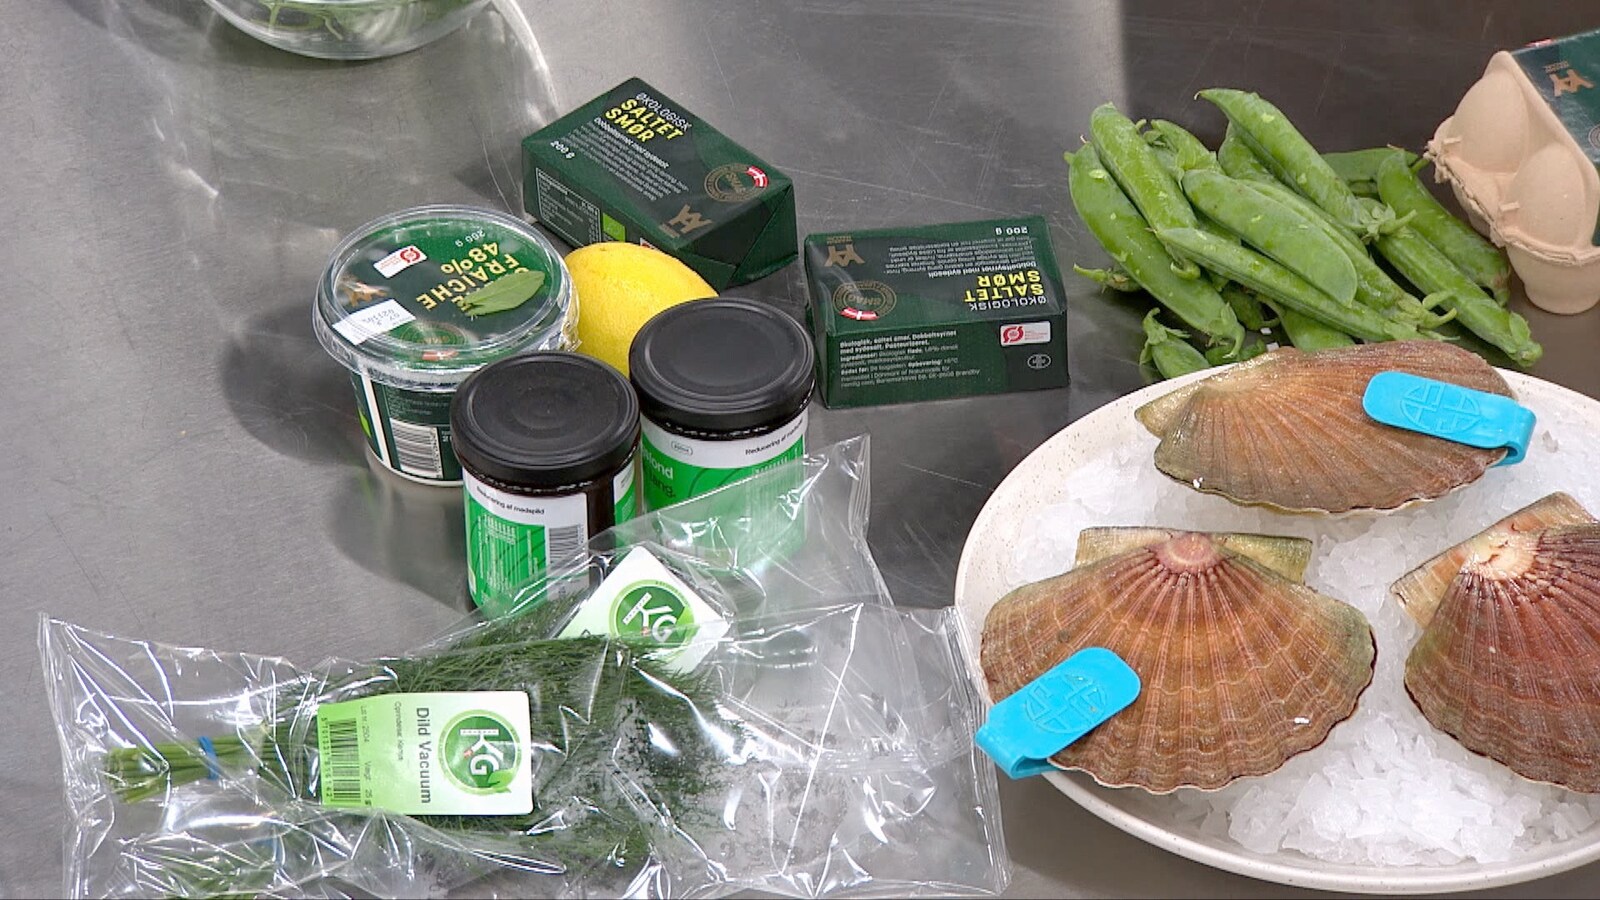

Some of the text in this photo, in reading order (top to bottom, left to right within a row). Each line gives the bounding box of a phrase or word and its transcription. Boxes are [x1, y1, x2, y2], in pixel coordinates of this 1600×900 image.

[621, 99, 684, 140] SALTET
[455, 229, 486, 248] 200 g
[441, 242, 498, 275] 48%
[964, 283, 1045, 302] SALTET
[977, 270, 1041, 287] SMØR
[969, 296, 1047, 312] ØKOLOGISK
[622, 592, 678, 643] KG
[416, 707, 432, 804] Dild Vacuum
[459, 728, 505, 775] KG
